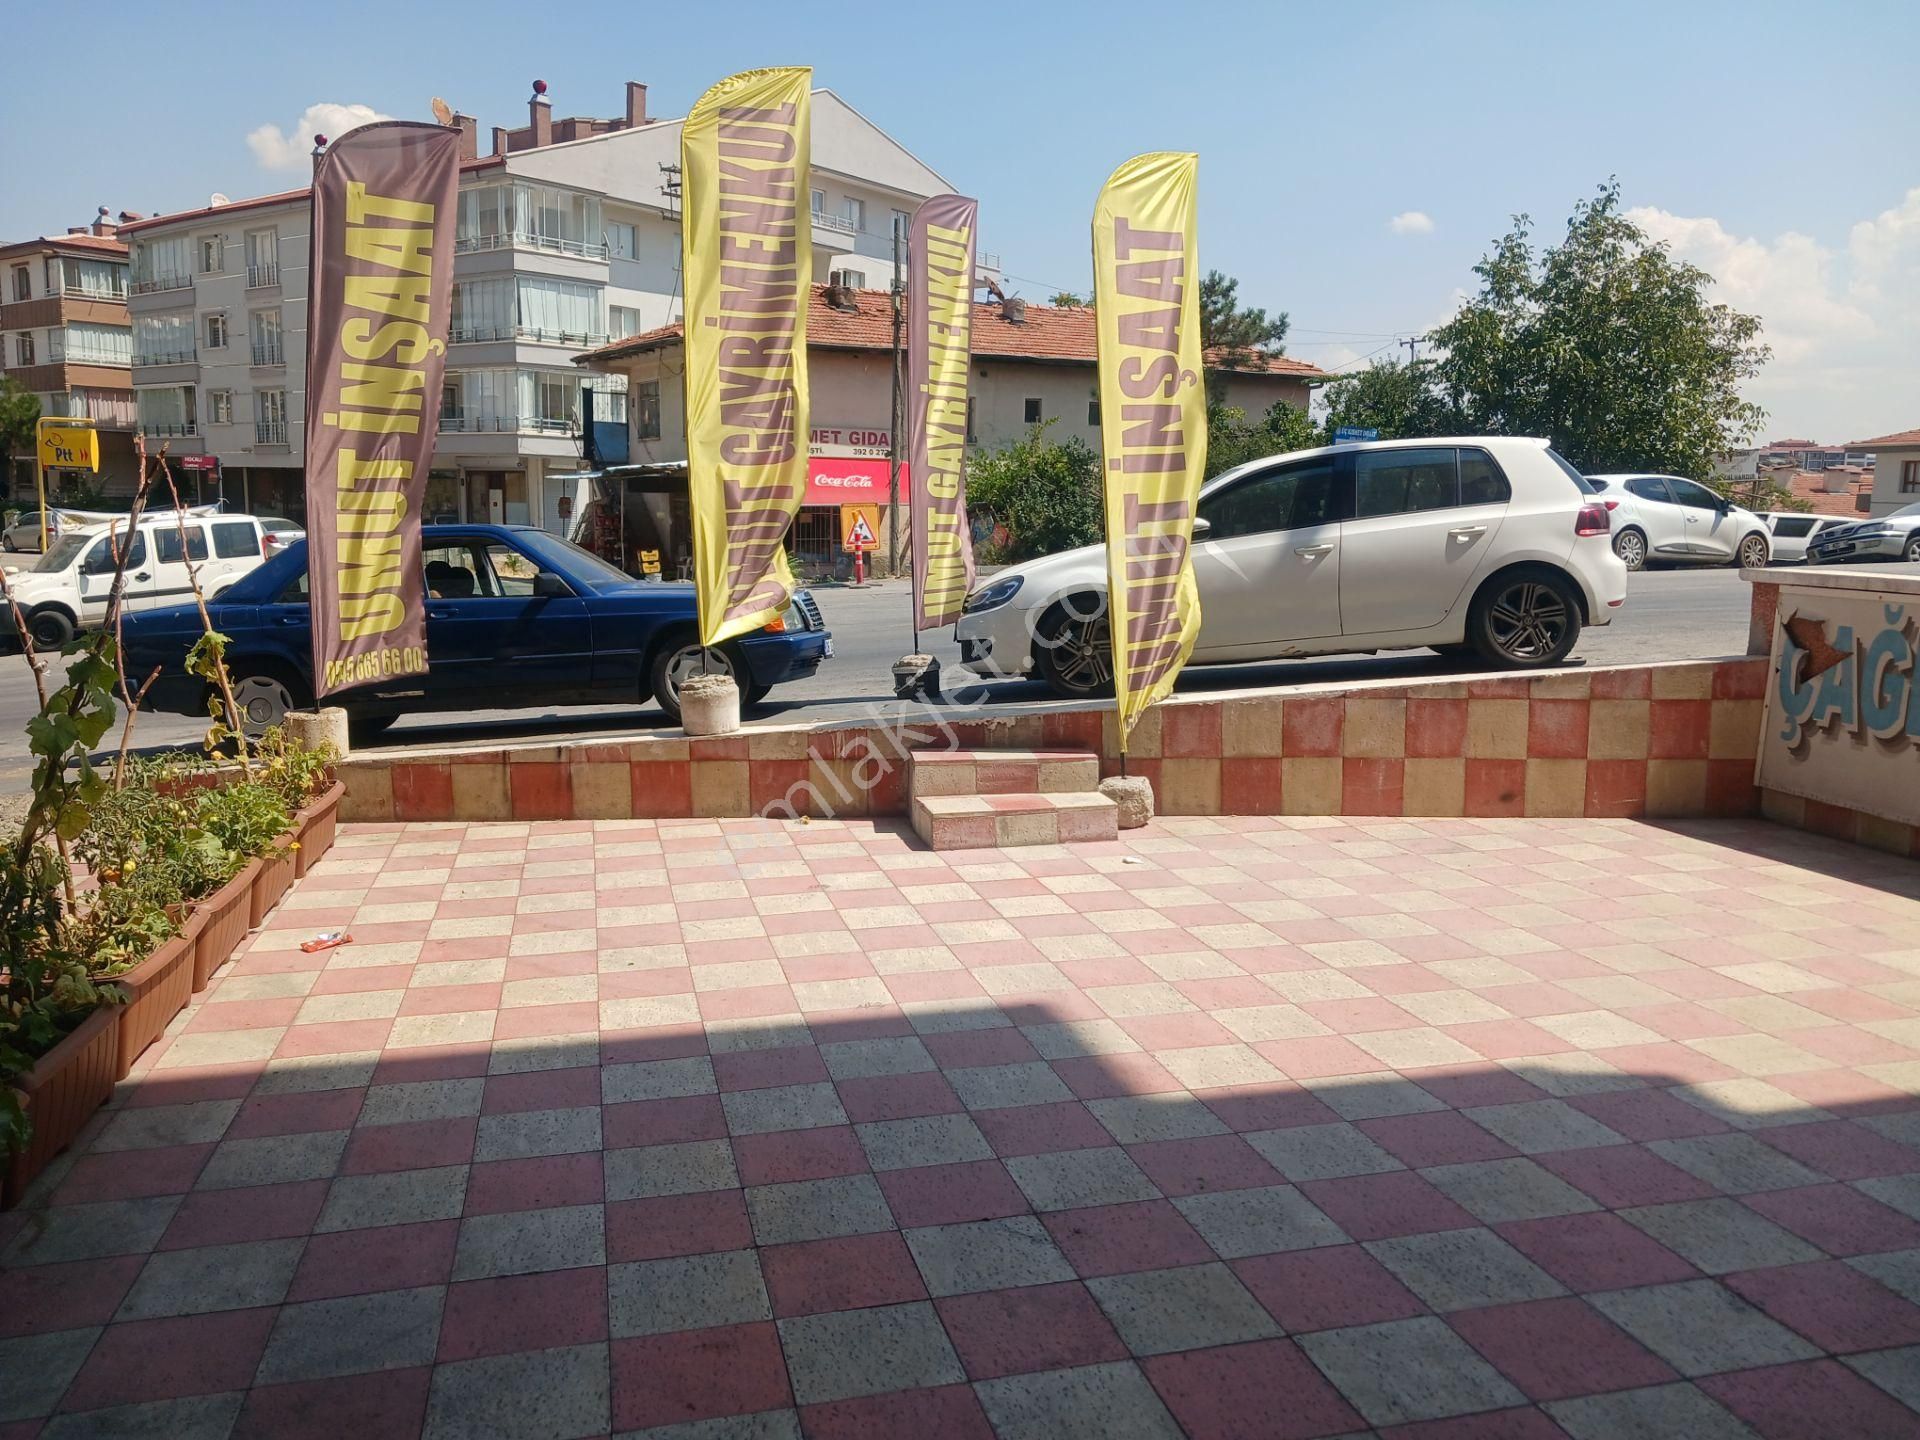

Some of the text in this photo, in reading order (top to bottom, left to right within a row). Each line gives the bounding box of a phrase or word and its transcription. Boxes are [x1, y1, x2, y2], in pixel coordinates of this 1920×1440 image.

[323, 180, 445, 641] UMUT İNŞAAT
[705, 102, 797, 622] UMUT GAYRİMENKUL
[849, 431, 889, 446] GIDA
[919, 223, 970, 618] UMUT GAYRİMENKUL
[1109, 216, 1197, 474] İNŞAAT
[55, 447, 73, 462] Ptt
[814, 473, 873, 488] Coca-Cola
[356, 651, 380, 680] 665
[381, 648, 401, 675] 66
[403, 646, 423, 672] 00
[1123, 493, 1189, 692] UMUT
